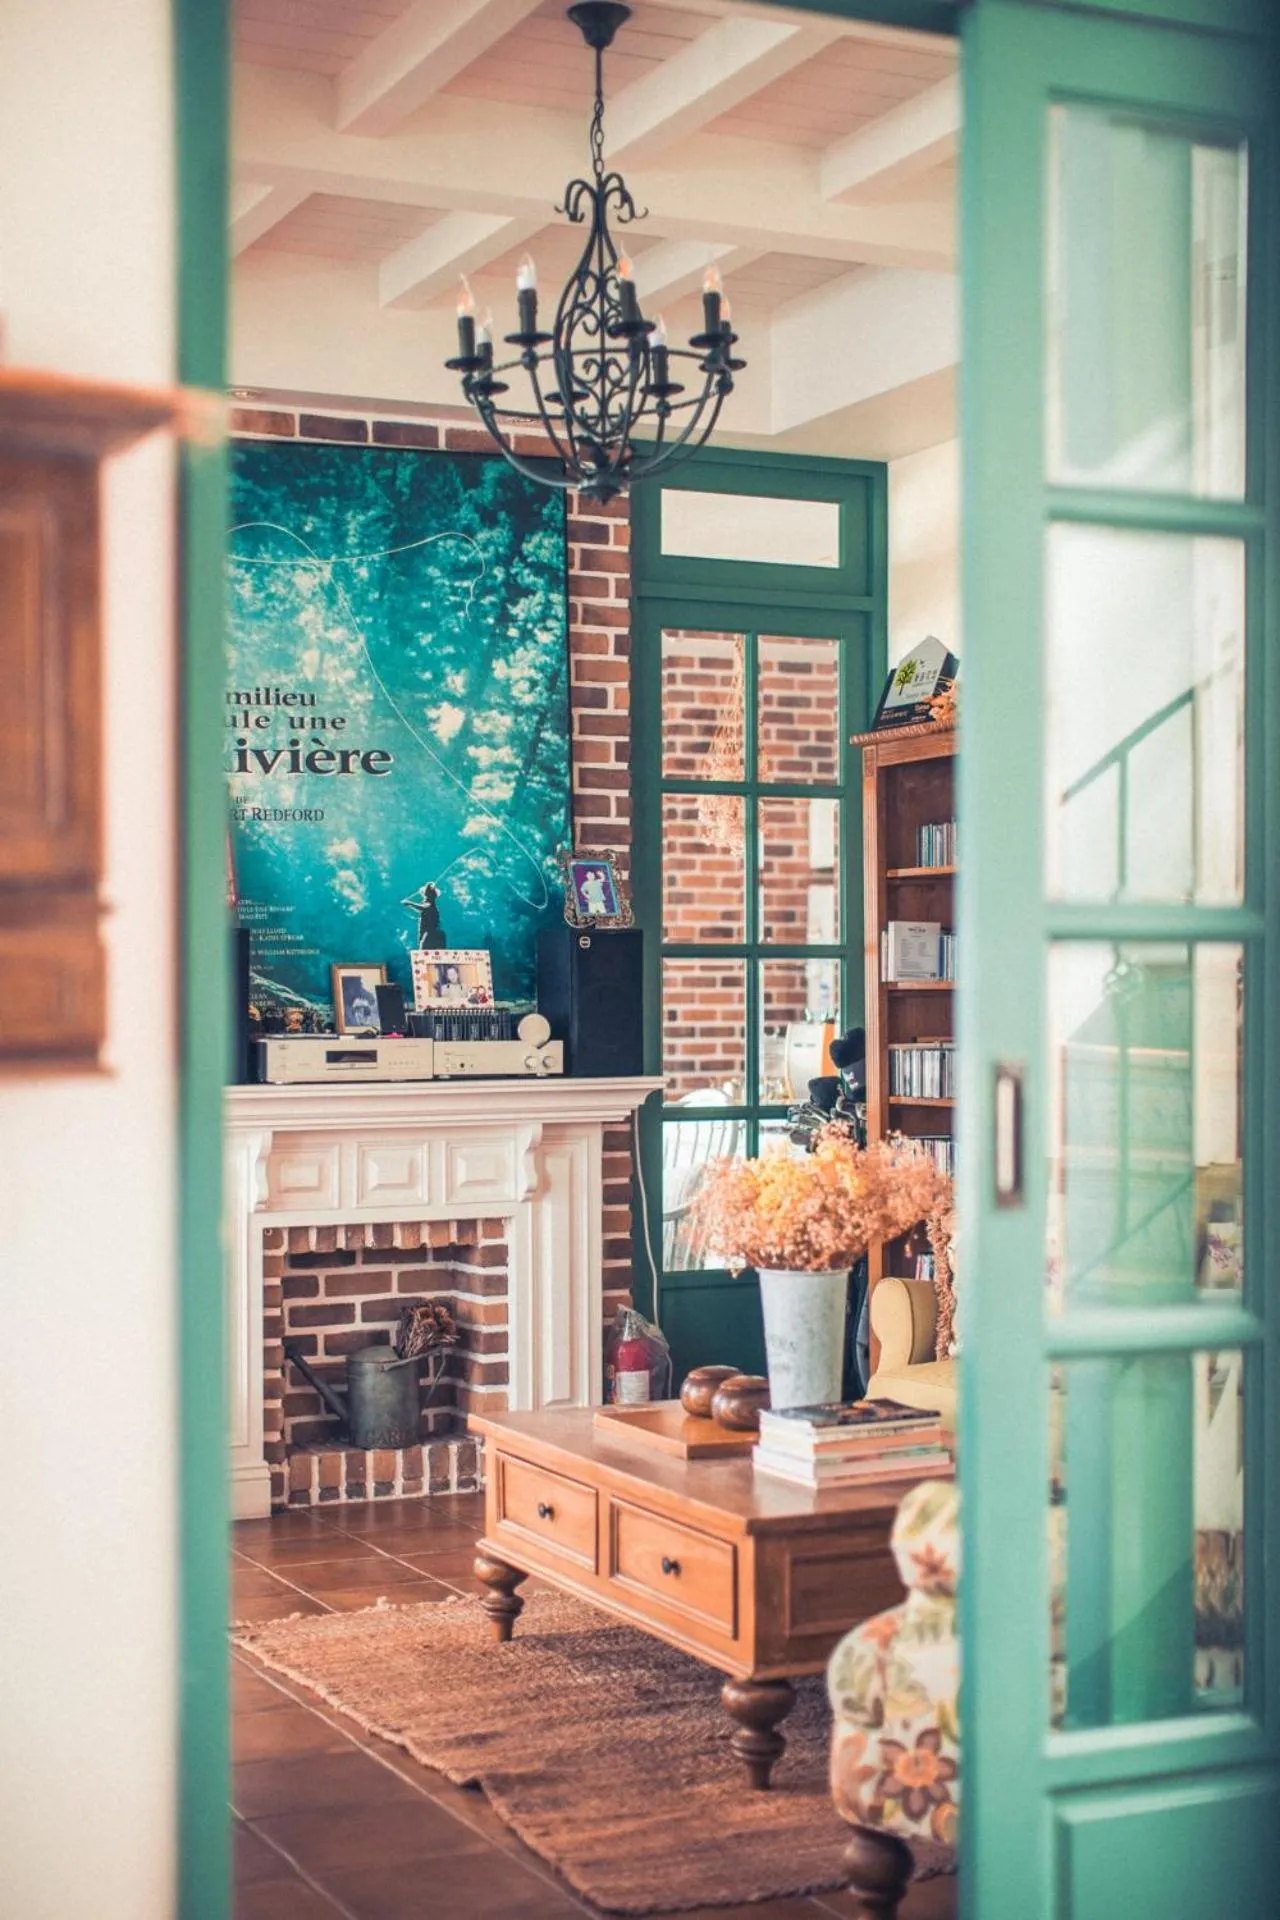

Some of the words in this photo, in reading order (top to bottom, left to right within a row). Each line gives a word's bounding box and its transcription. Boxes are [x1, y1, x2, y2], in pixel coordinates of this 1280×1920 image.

[226, 687, 316, 706] milieu
[288, 715, 347, 730] une
[226, 738, 393, 775] ivière
[252, 807, 325, 821] REDFORD
